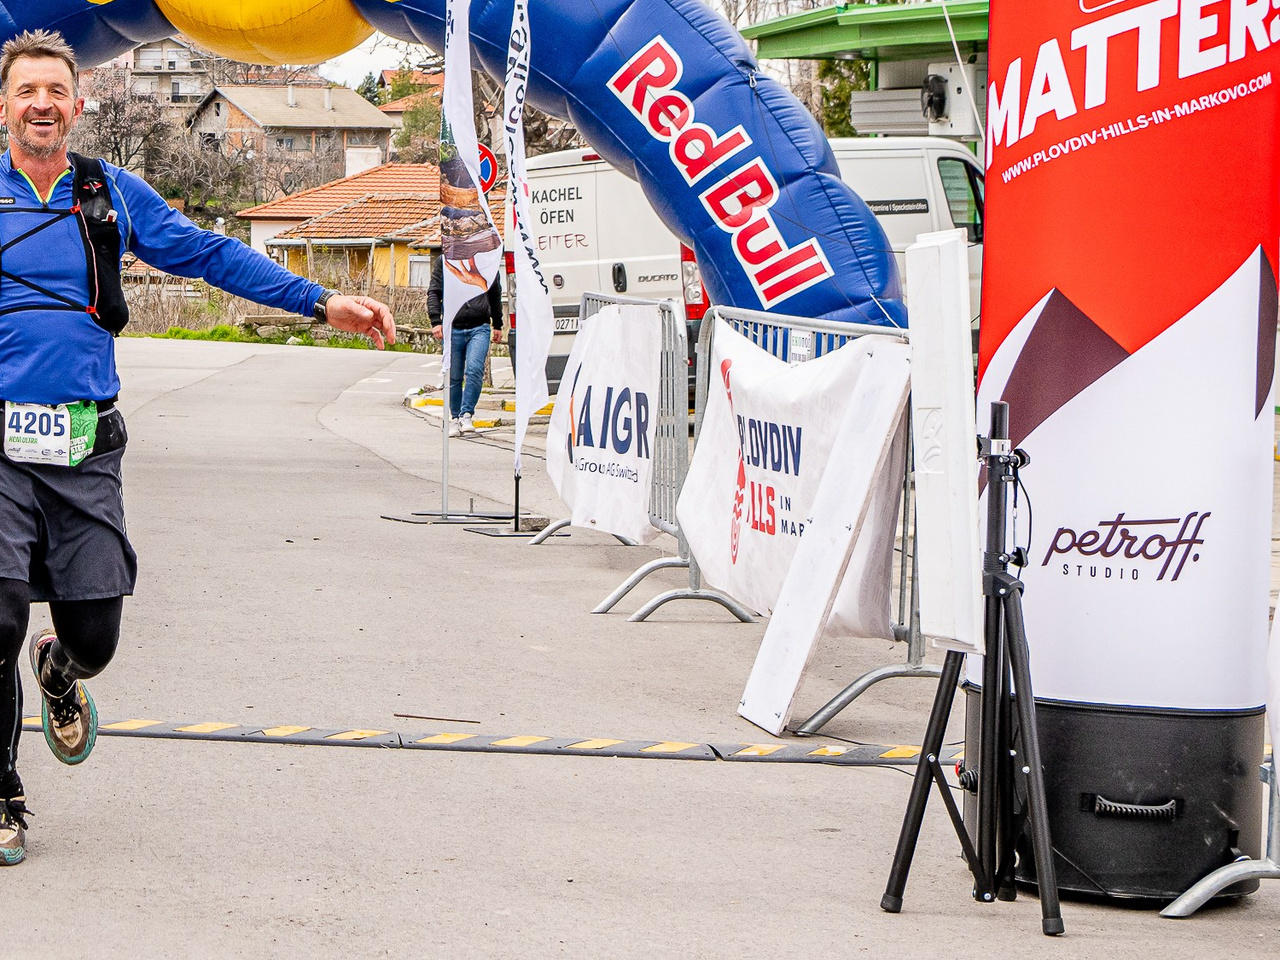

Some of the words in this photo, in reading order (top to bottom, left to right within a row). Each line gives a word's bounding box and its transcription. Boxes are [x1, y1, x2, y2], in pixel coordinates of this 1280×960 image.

[1001, 71, 1272, 183] WWW.PLOVDIV-HILLS-IN-MARKOVO.COM
[610, 39, 748, 182] Red
[703, 160, 830, 306] Bull
[532, 187, 583, 203] KACHEL
[540, 208, 574, 224] ÖFEN
[536, 233, 589, 251] EITER
[638, 274, 679, 283] DUCATO
[8, 411, 65, 437] 4205
[737, 414, 802, 476] POVDIV
[780, 495, 791, 512] IN
[1062, 564, 1139, 580] STUDIO
